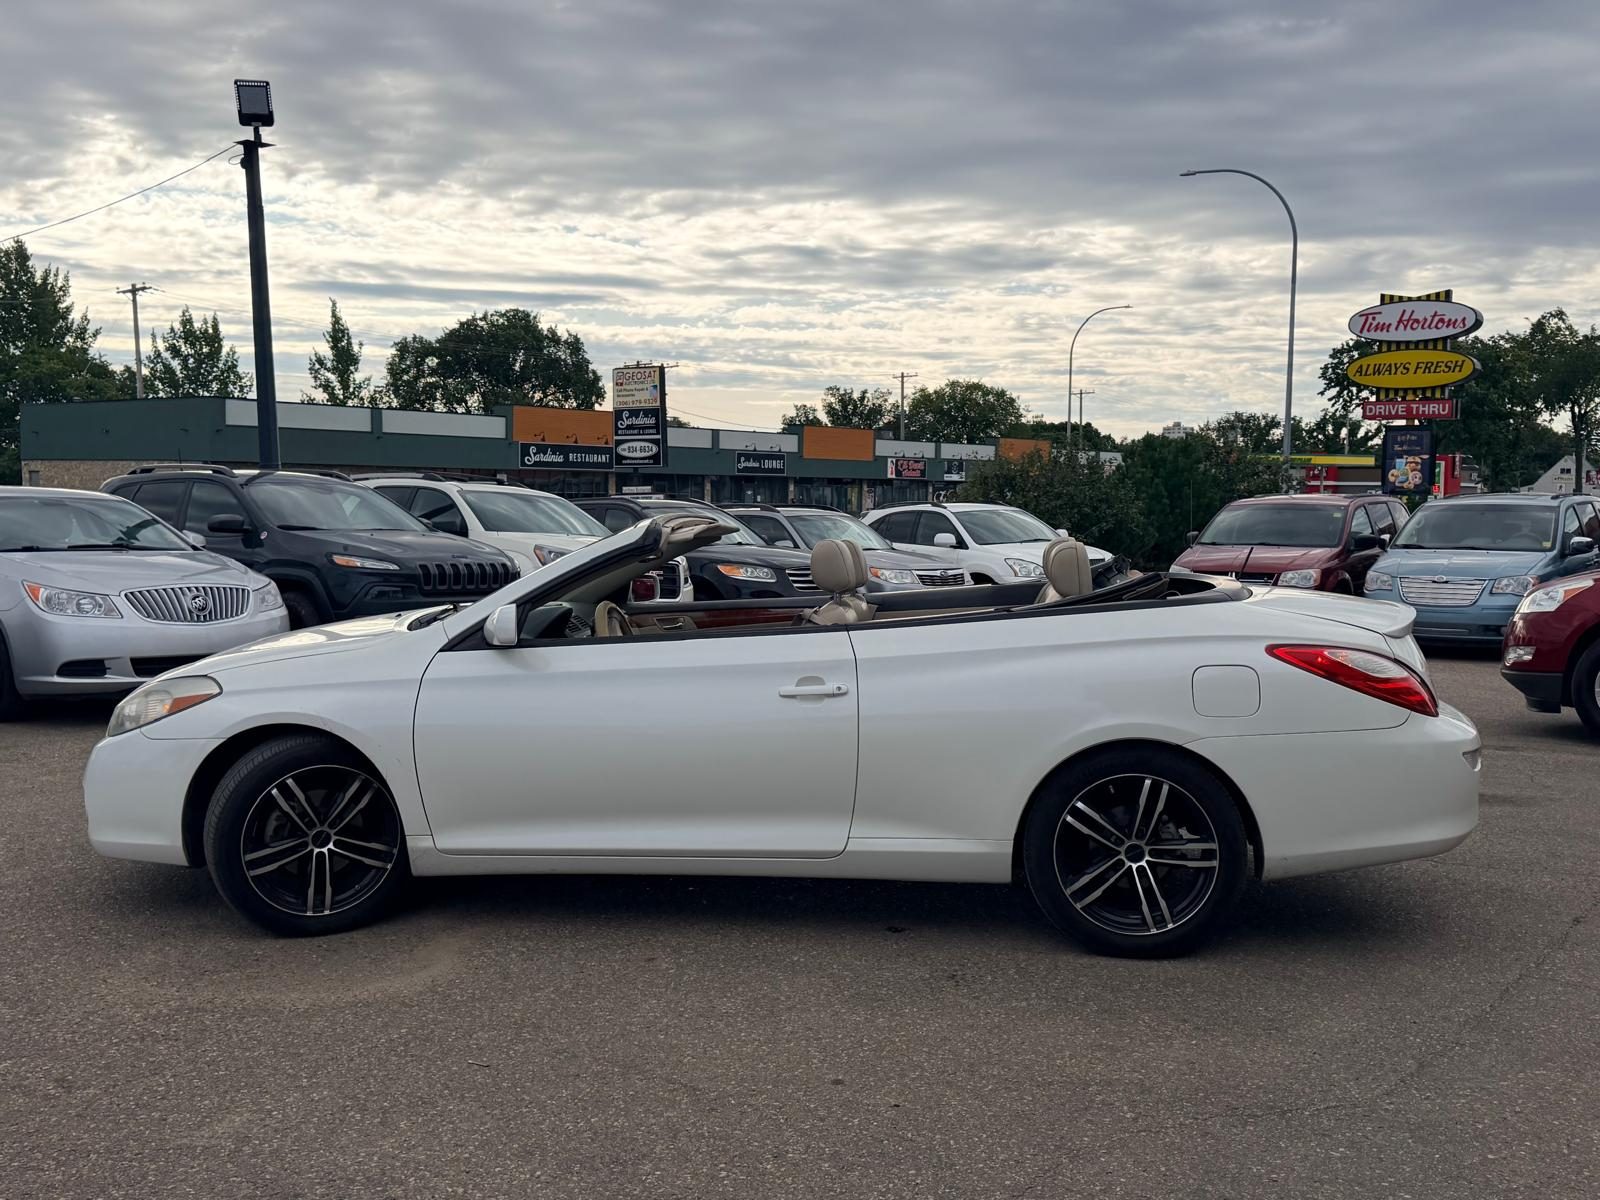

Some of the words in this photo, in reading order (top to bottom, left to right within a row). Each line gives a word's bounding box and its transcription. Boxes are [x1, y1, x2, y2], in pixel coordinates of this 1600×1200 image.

[1358, 312, 1392, 334] Tim
[1395, 309, 1468, 331] Hortons
[624, 370, 656, 380] GEOSAT
[1354, 362, 1412, 377] ALWAYS
[1413, 360, 1466, 374] FRESH
[1366, 405, 1406, 416] DRIVE
[1411, 404, 1449, 414] THRU
[618, 411, 656, 428] Sardinia
[525, 446, 564, 464] Sardinia
[569, 453, 610, 463] RESTAURANT
[761, 460, 784, 468] LOUNGE
